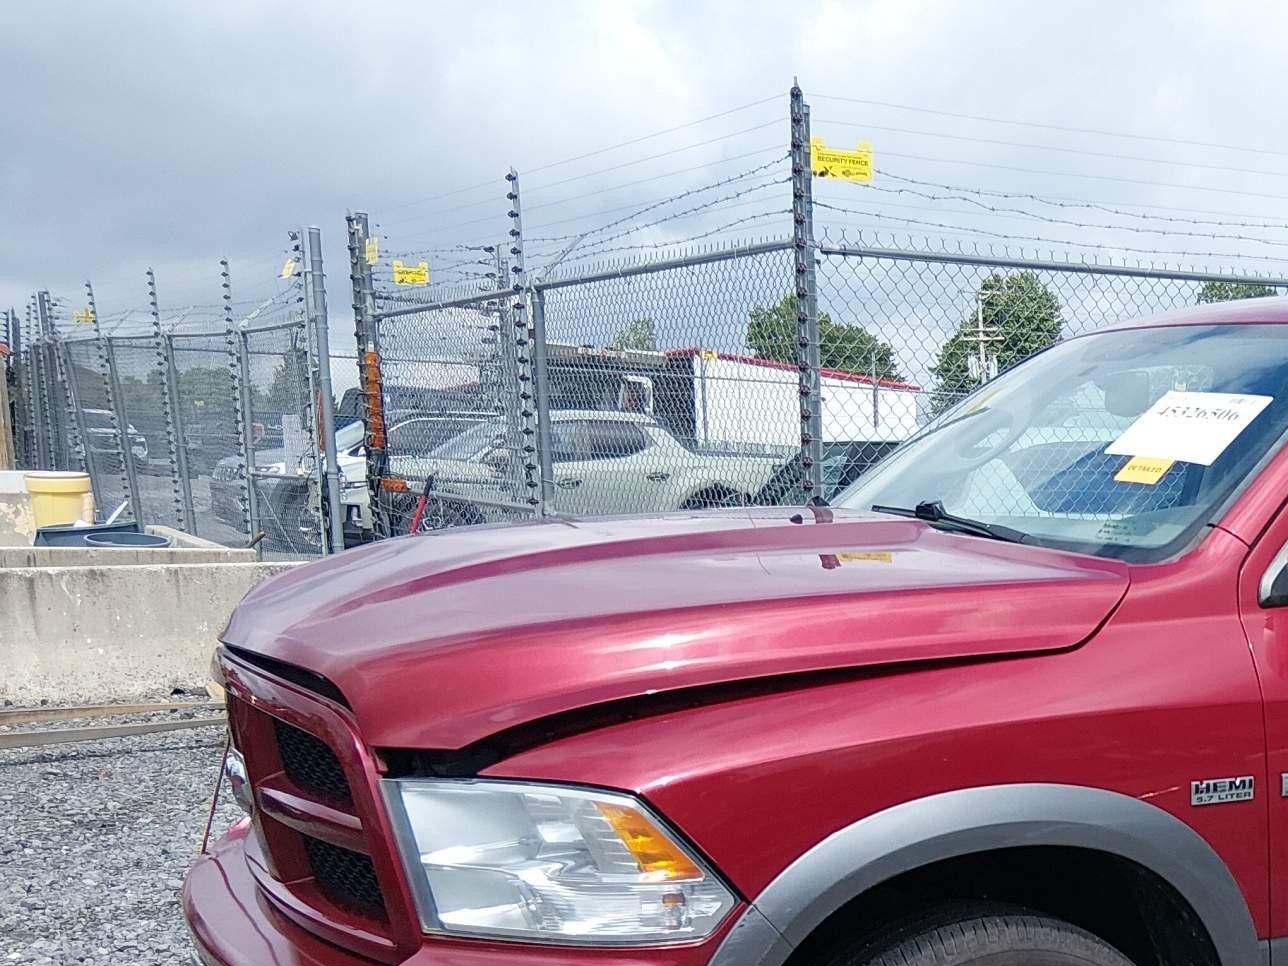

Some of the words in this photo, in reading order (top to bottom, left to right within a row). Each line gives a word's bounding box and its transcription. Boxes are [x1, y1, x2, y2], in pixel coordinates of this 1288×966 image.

[817, 155, 847, 165] SECURITY
[848, 159, 869, 167] FENCE
[1157, 405, 1240, 422] 45326506
[1194, 778, 1253, 796] HEMI
[1196, 795, 1214, 803] 5.7
[1218, 791, 1251, 801] LITER
